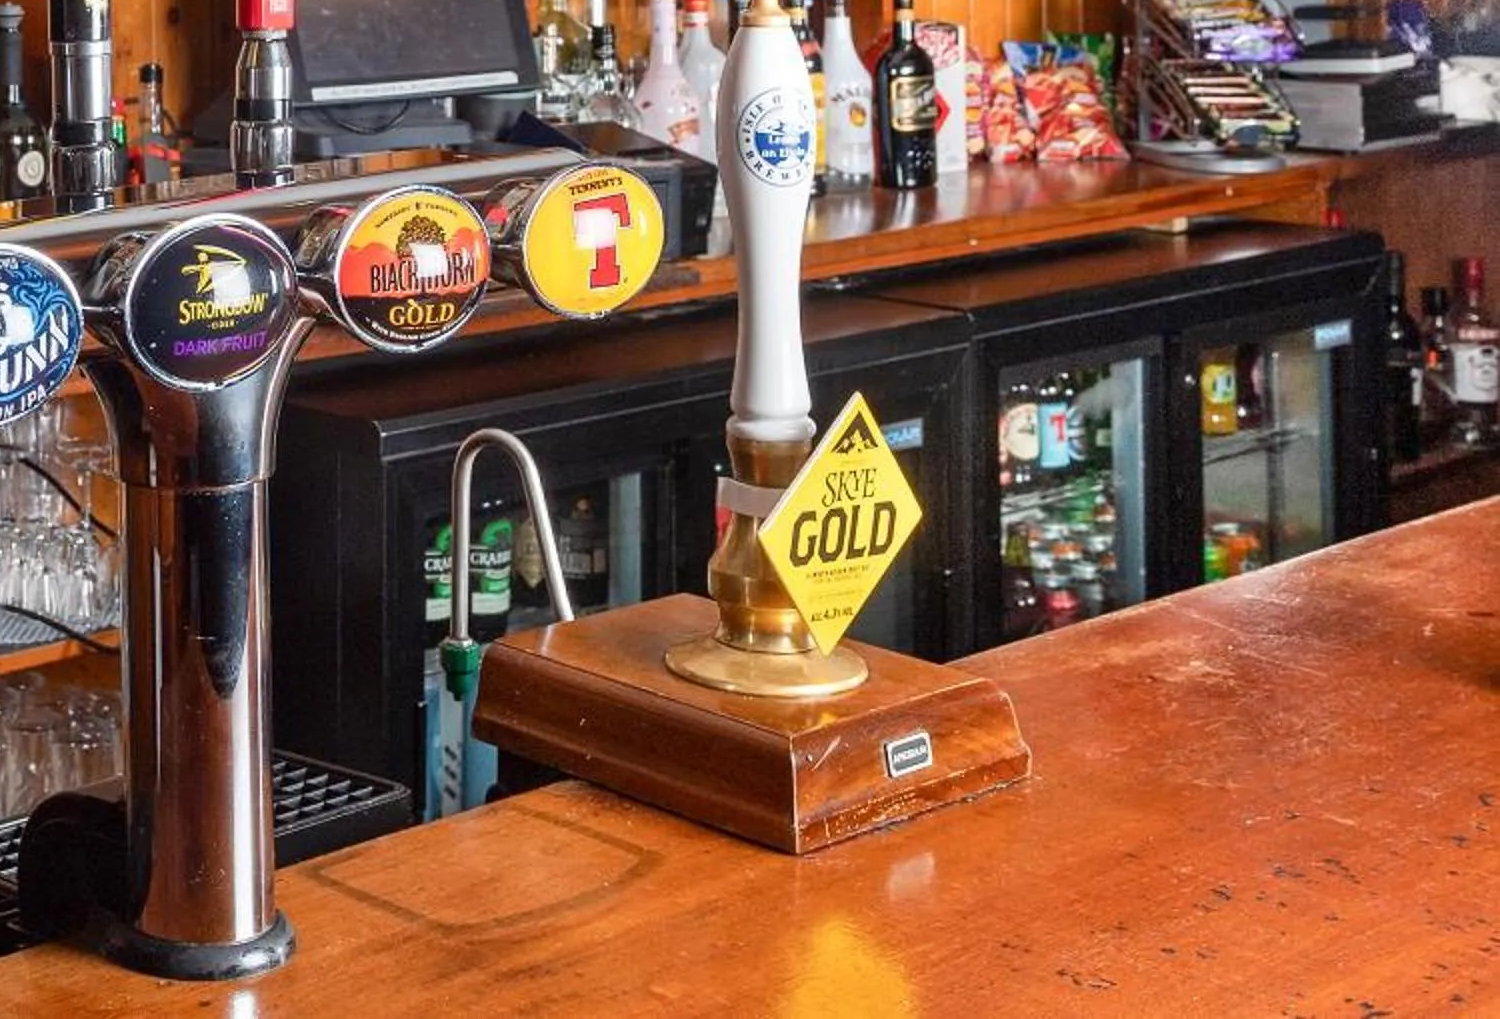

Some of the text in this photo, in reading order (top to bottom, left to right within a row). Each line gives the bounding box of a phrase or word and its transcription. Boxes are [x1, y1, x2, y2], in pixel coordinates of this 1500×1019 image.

[389, 298, 455, 326] GOLD
[173, 331, 267, 356] DARK FRUIT
[21, 384, 49, 411] IPA
[821, 468, 877, 507] SKYE
[789, 500, 897, 567] GOLD
